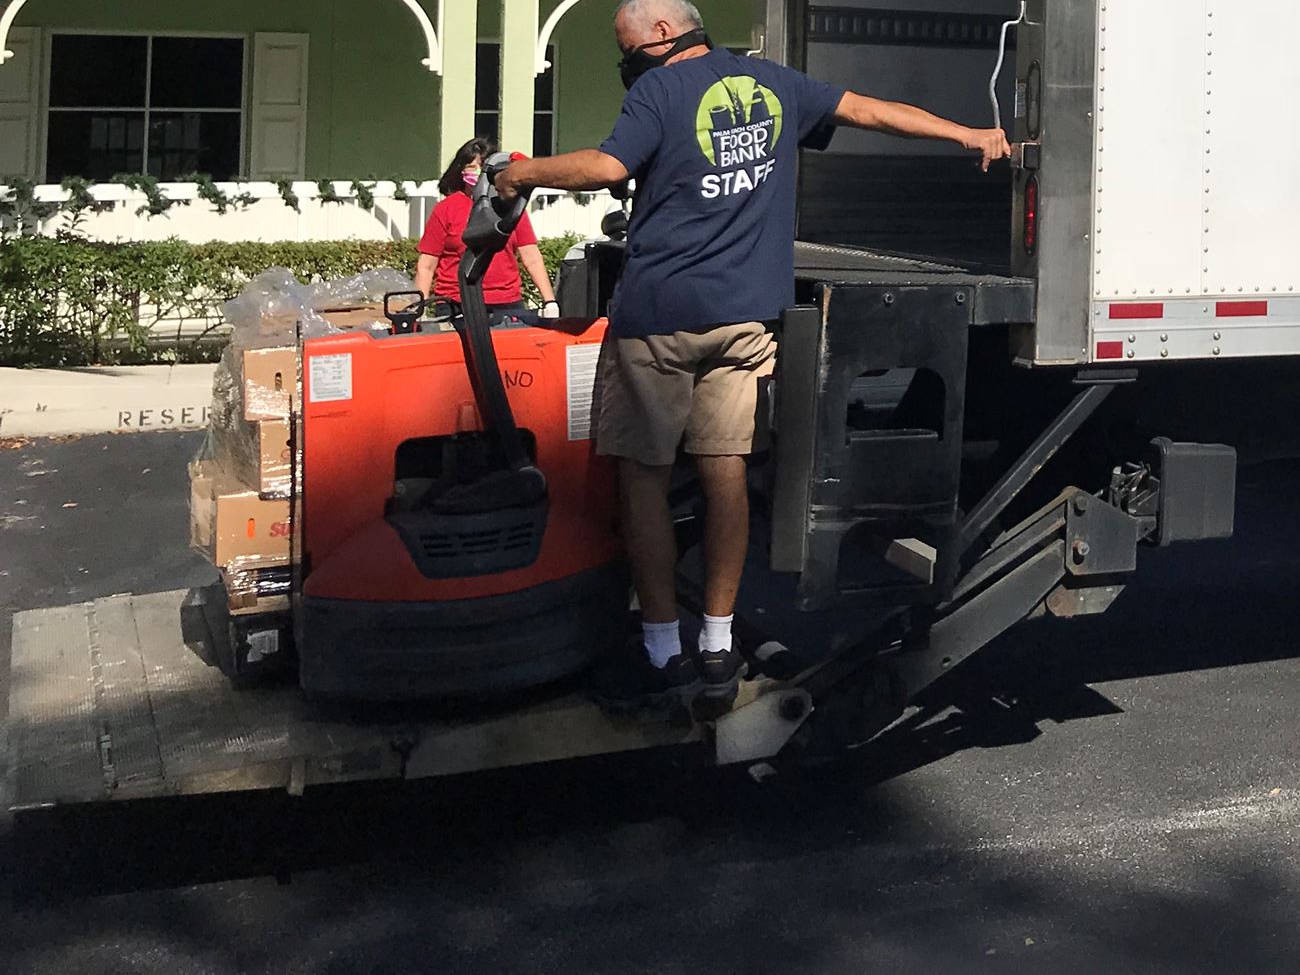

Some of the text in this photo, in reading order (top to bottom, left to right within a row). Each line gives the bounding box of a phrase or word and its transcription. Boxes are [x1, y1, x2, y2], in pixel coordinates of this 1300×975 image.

[720, 127, 768, 151] FOOD
[720, 142, 767, 167] BANK
[701, 158, 776, 199] STAFF
